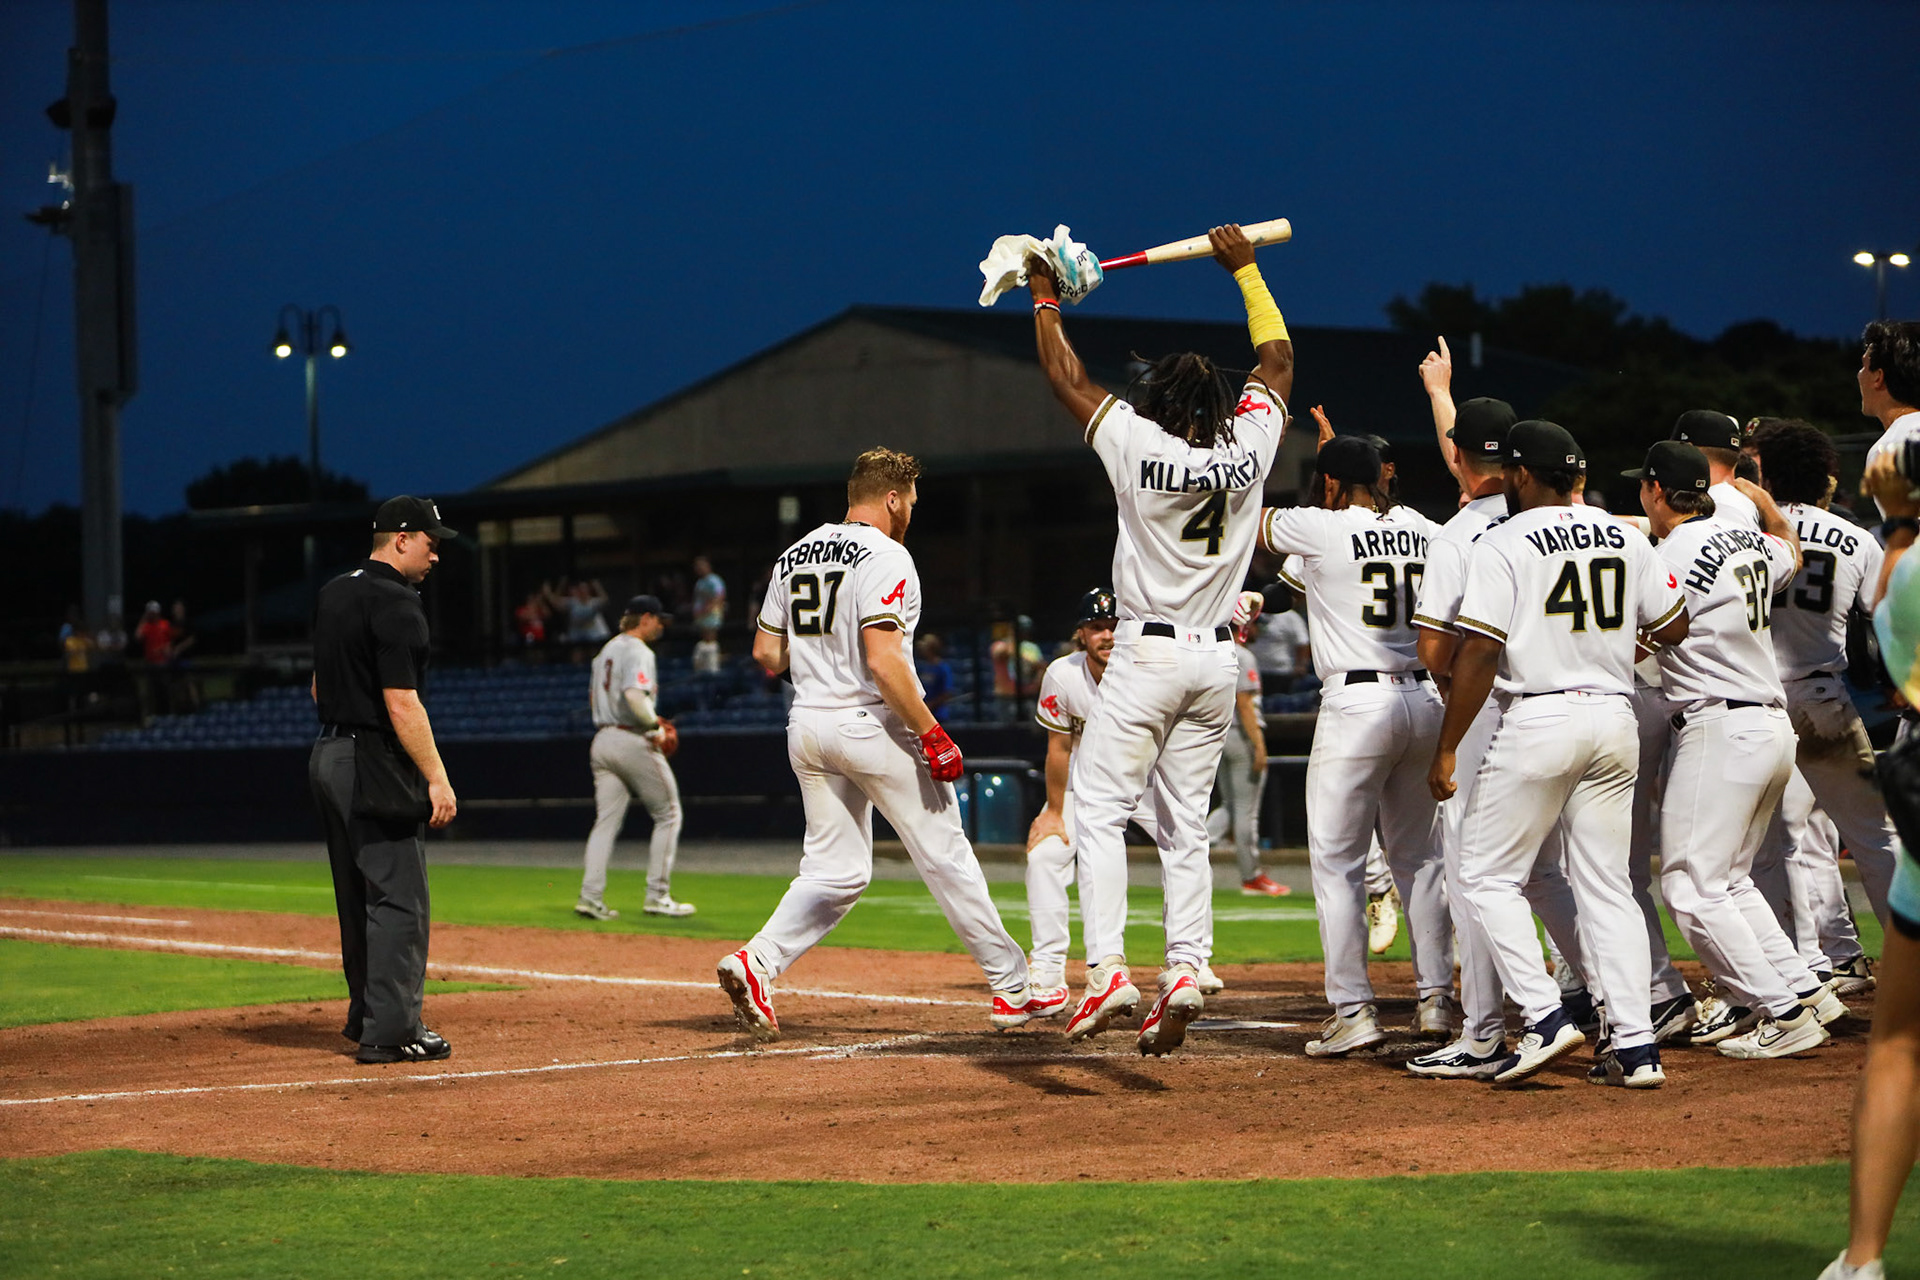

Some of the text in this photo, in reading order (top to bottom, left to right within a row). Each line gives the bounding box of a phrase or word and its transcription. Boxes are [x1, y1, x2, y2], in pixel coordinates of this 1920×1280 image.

[1140, 450, 1260, 493] KILPATRICK
[1180, 489, 1229, 557] 4
[1525, 523, 1625, 557] VARGAS
[1797, 520, 1859, 556] LLOS
[790, 571, 845, 637] 27
[1544, 556, 1626, 632] 40
[1733, 559, 1771, 633] 32
[1773, 549, 1838, 615] 3
